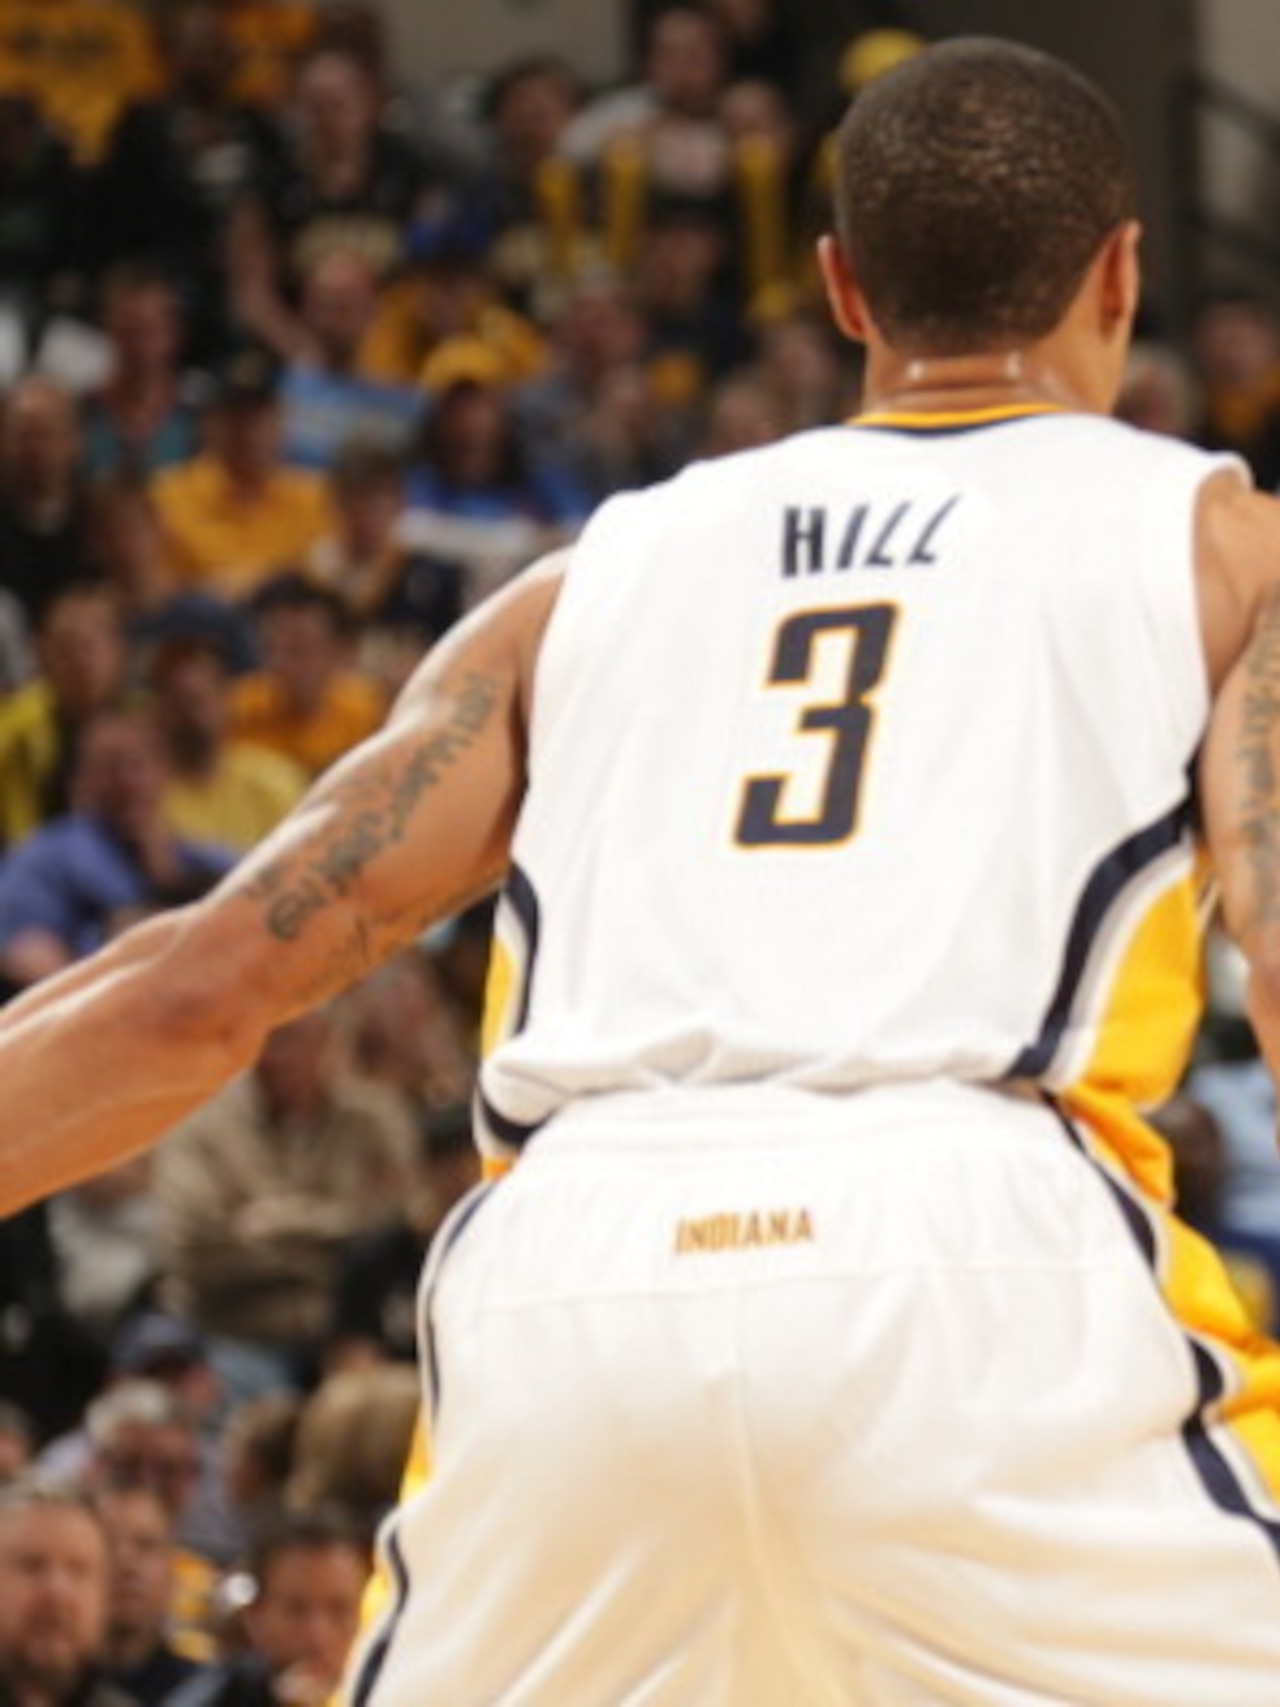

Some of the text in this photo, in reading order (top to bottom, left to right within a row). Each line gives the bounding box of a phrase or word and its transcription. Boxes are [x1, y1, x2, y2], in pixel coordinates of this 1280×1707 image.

[780, 494, 961, 578] HILL
[731, 600, 900, 849] 3
[674, 1208, 814, 1256] INDIANA
